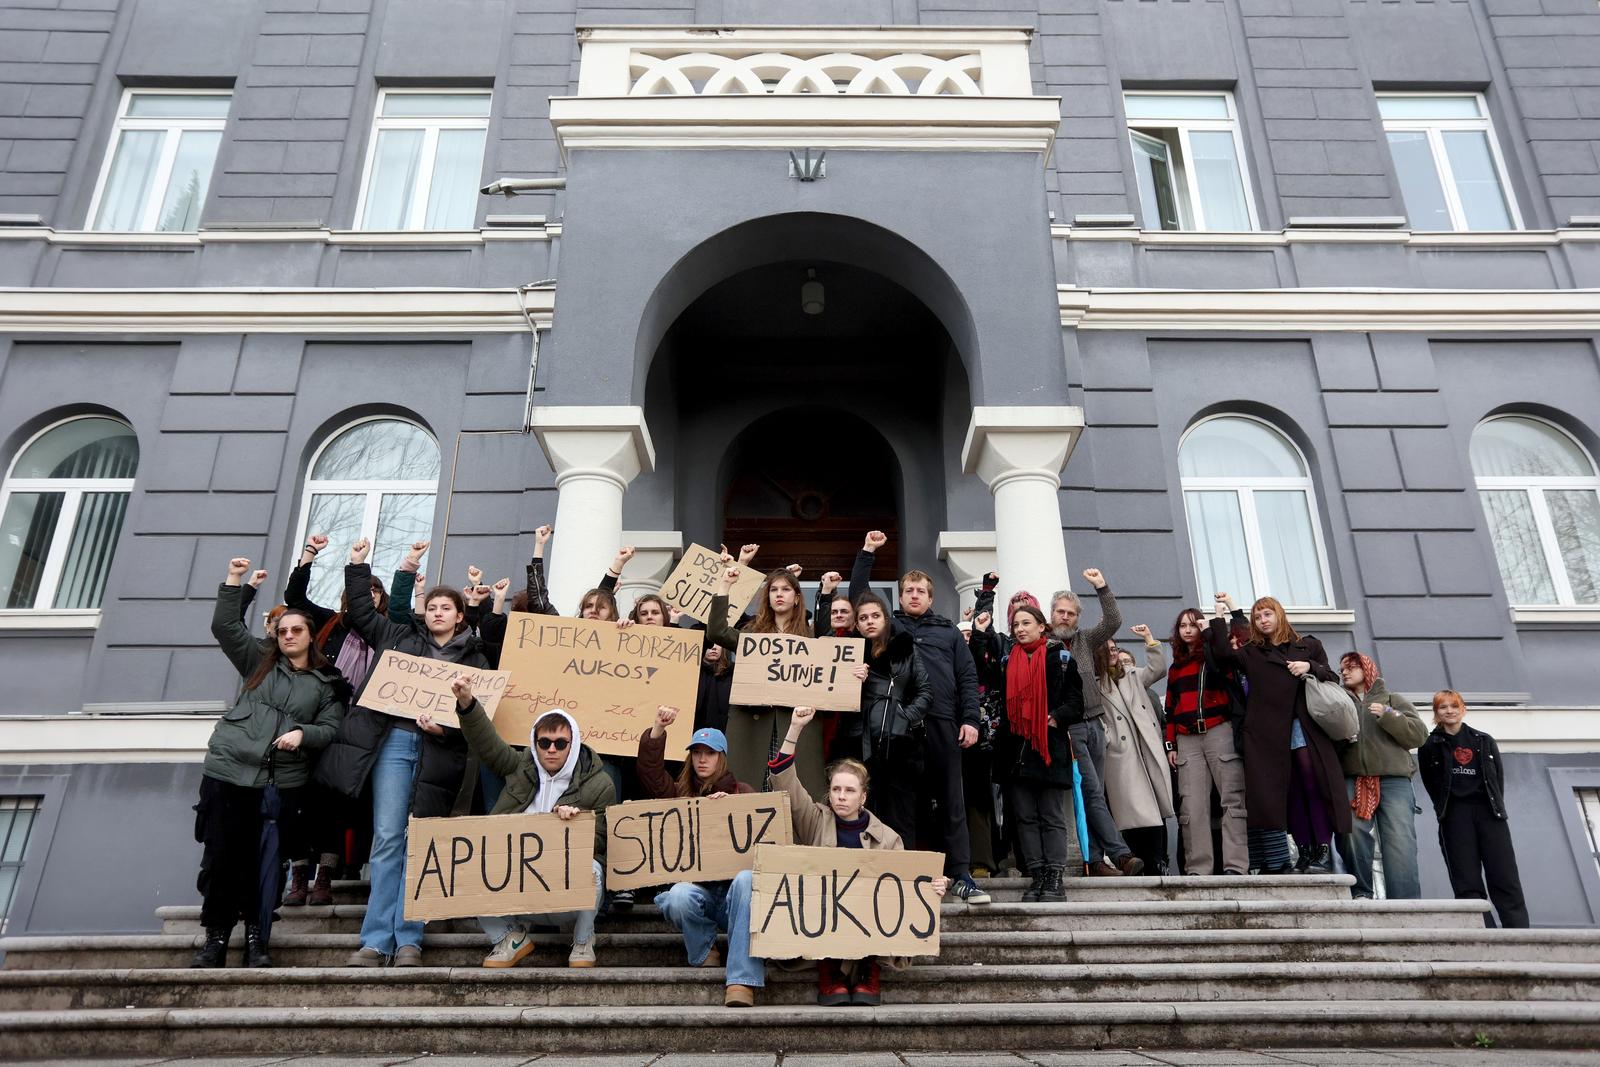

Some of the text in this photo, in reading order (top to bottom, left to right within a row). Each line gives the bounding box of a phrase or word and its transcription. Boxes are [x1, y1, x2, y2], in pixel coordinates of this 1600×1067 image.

[693, 552, 730, 578] DOST
[699, 573, 717, 587] JE
[518, 618, 701, 666] RIJEKA PODRŽAVA
[743, 637, 856, 662] DOSTA JE
[388, 655, 506, 690] PODRŽAAMO
[563, 657, 658, 685] AUKOS!
[378, 681, 460, 713] OSIJE
[1452, 766, 1476, 775] celona
[728, 807, 777, 853] UZ
[414, 827, 570, 900] APURI
[760, 869, 936, 939] AUKOS
